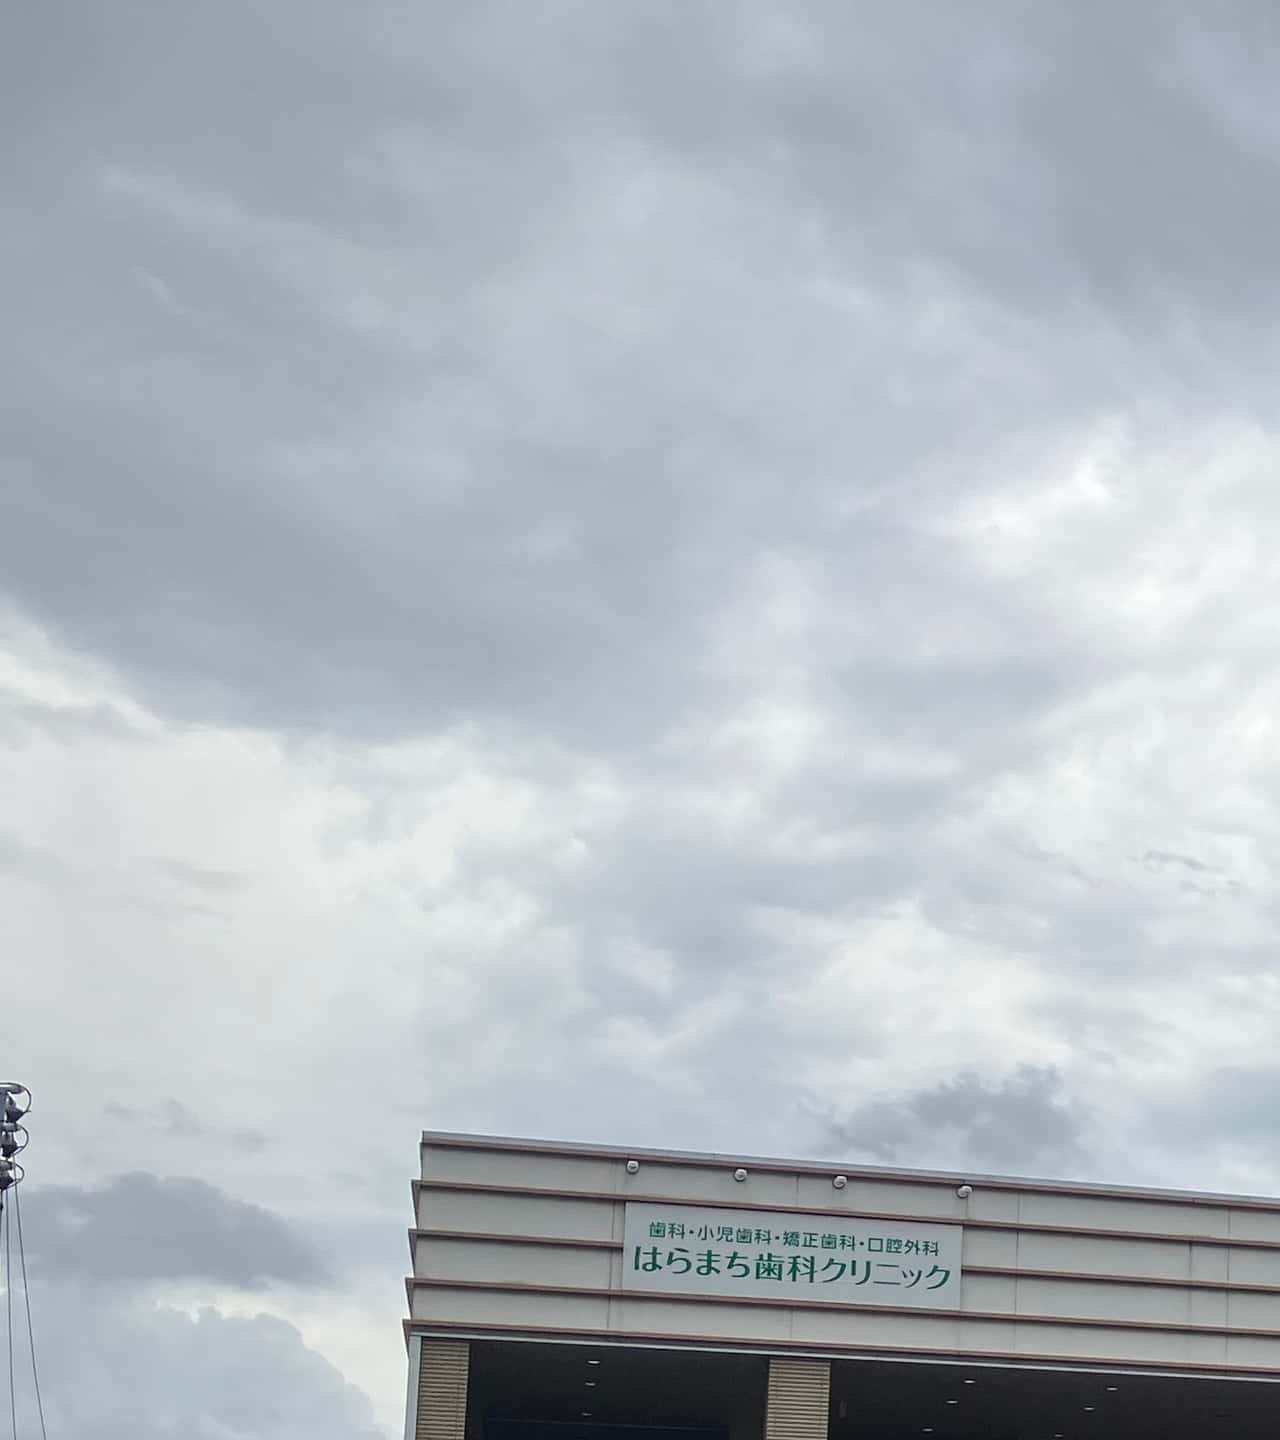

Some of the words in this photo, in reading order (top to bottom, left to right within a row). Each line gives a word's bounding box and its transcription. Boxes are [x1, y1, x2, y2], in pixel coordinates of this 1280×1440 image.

[649, 1221, 939, 1256] 歯科・小児歯科・矯正歯科・口腔外科
[634, 1246, 950, 1290] はらまち歯科クリニック
